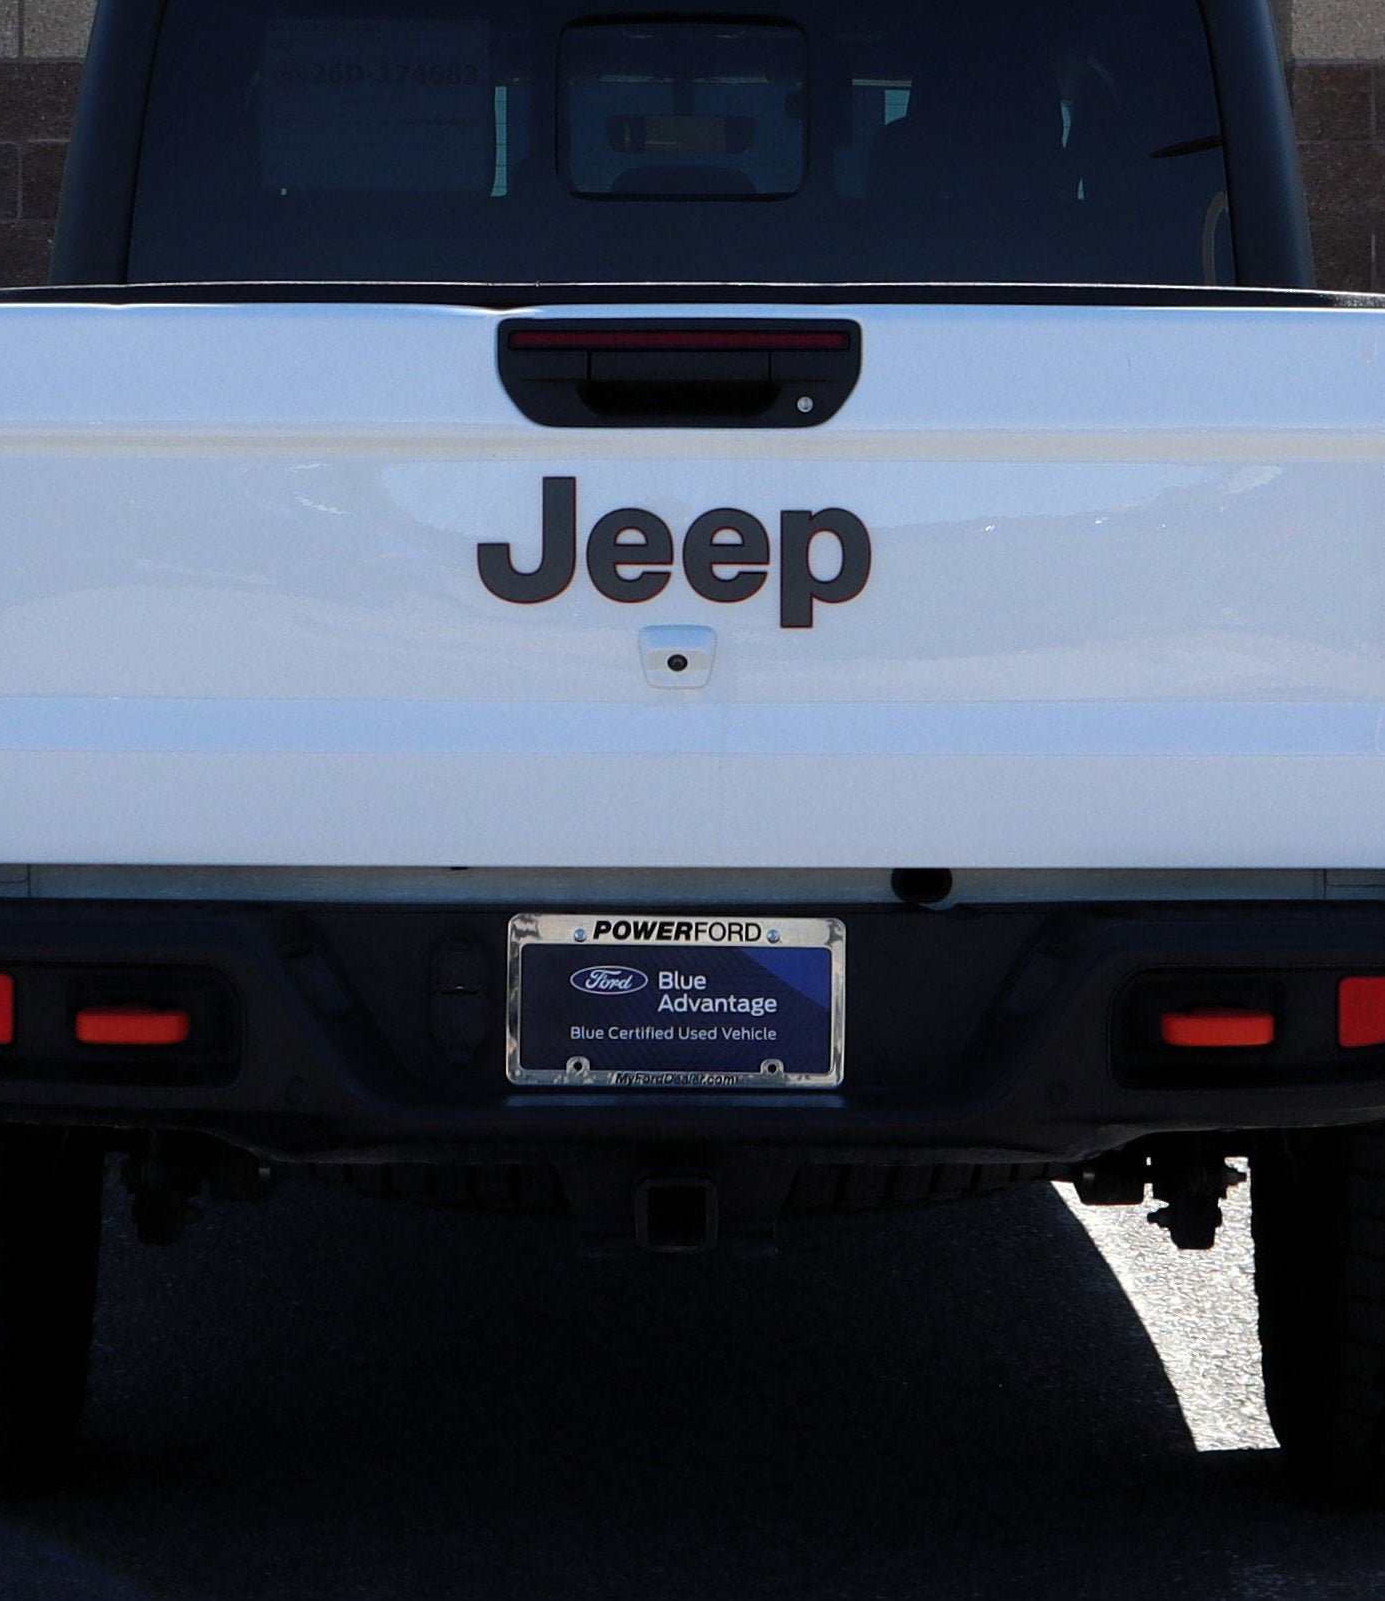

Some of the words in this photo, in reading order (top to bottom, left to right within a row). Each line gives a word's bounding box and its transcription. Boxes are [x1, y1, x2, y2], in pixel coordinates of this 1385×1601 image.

[477, 476, 872, 629] Jeep
[592, 920, 763, 943] POWERFORD
[584, 969, 633, 991] Ford
[657, 971, 707, 990] Blue
[657, 994, 778, 1017] Advantage
[570, 1026, 605, 1040] Blue
[608, 1026, 674, 1041] Certified
[678, 1027, 717, 1041] Used
[721, 1027, 778, 1041] Vehicle
